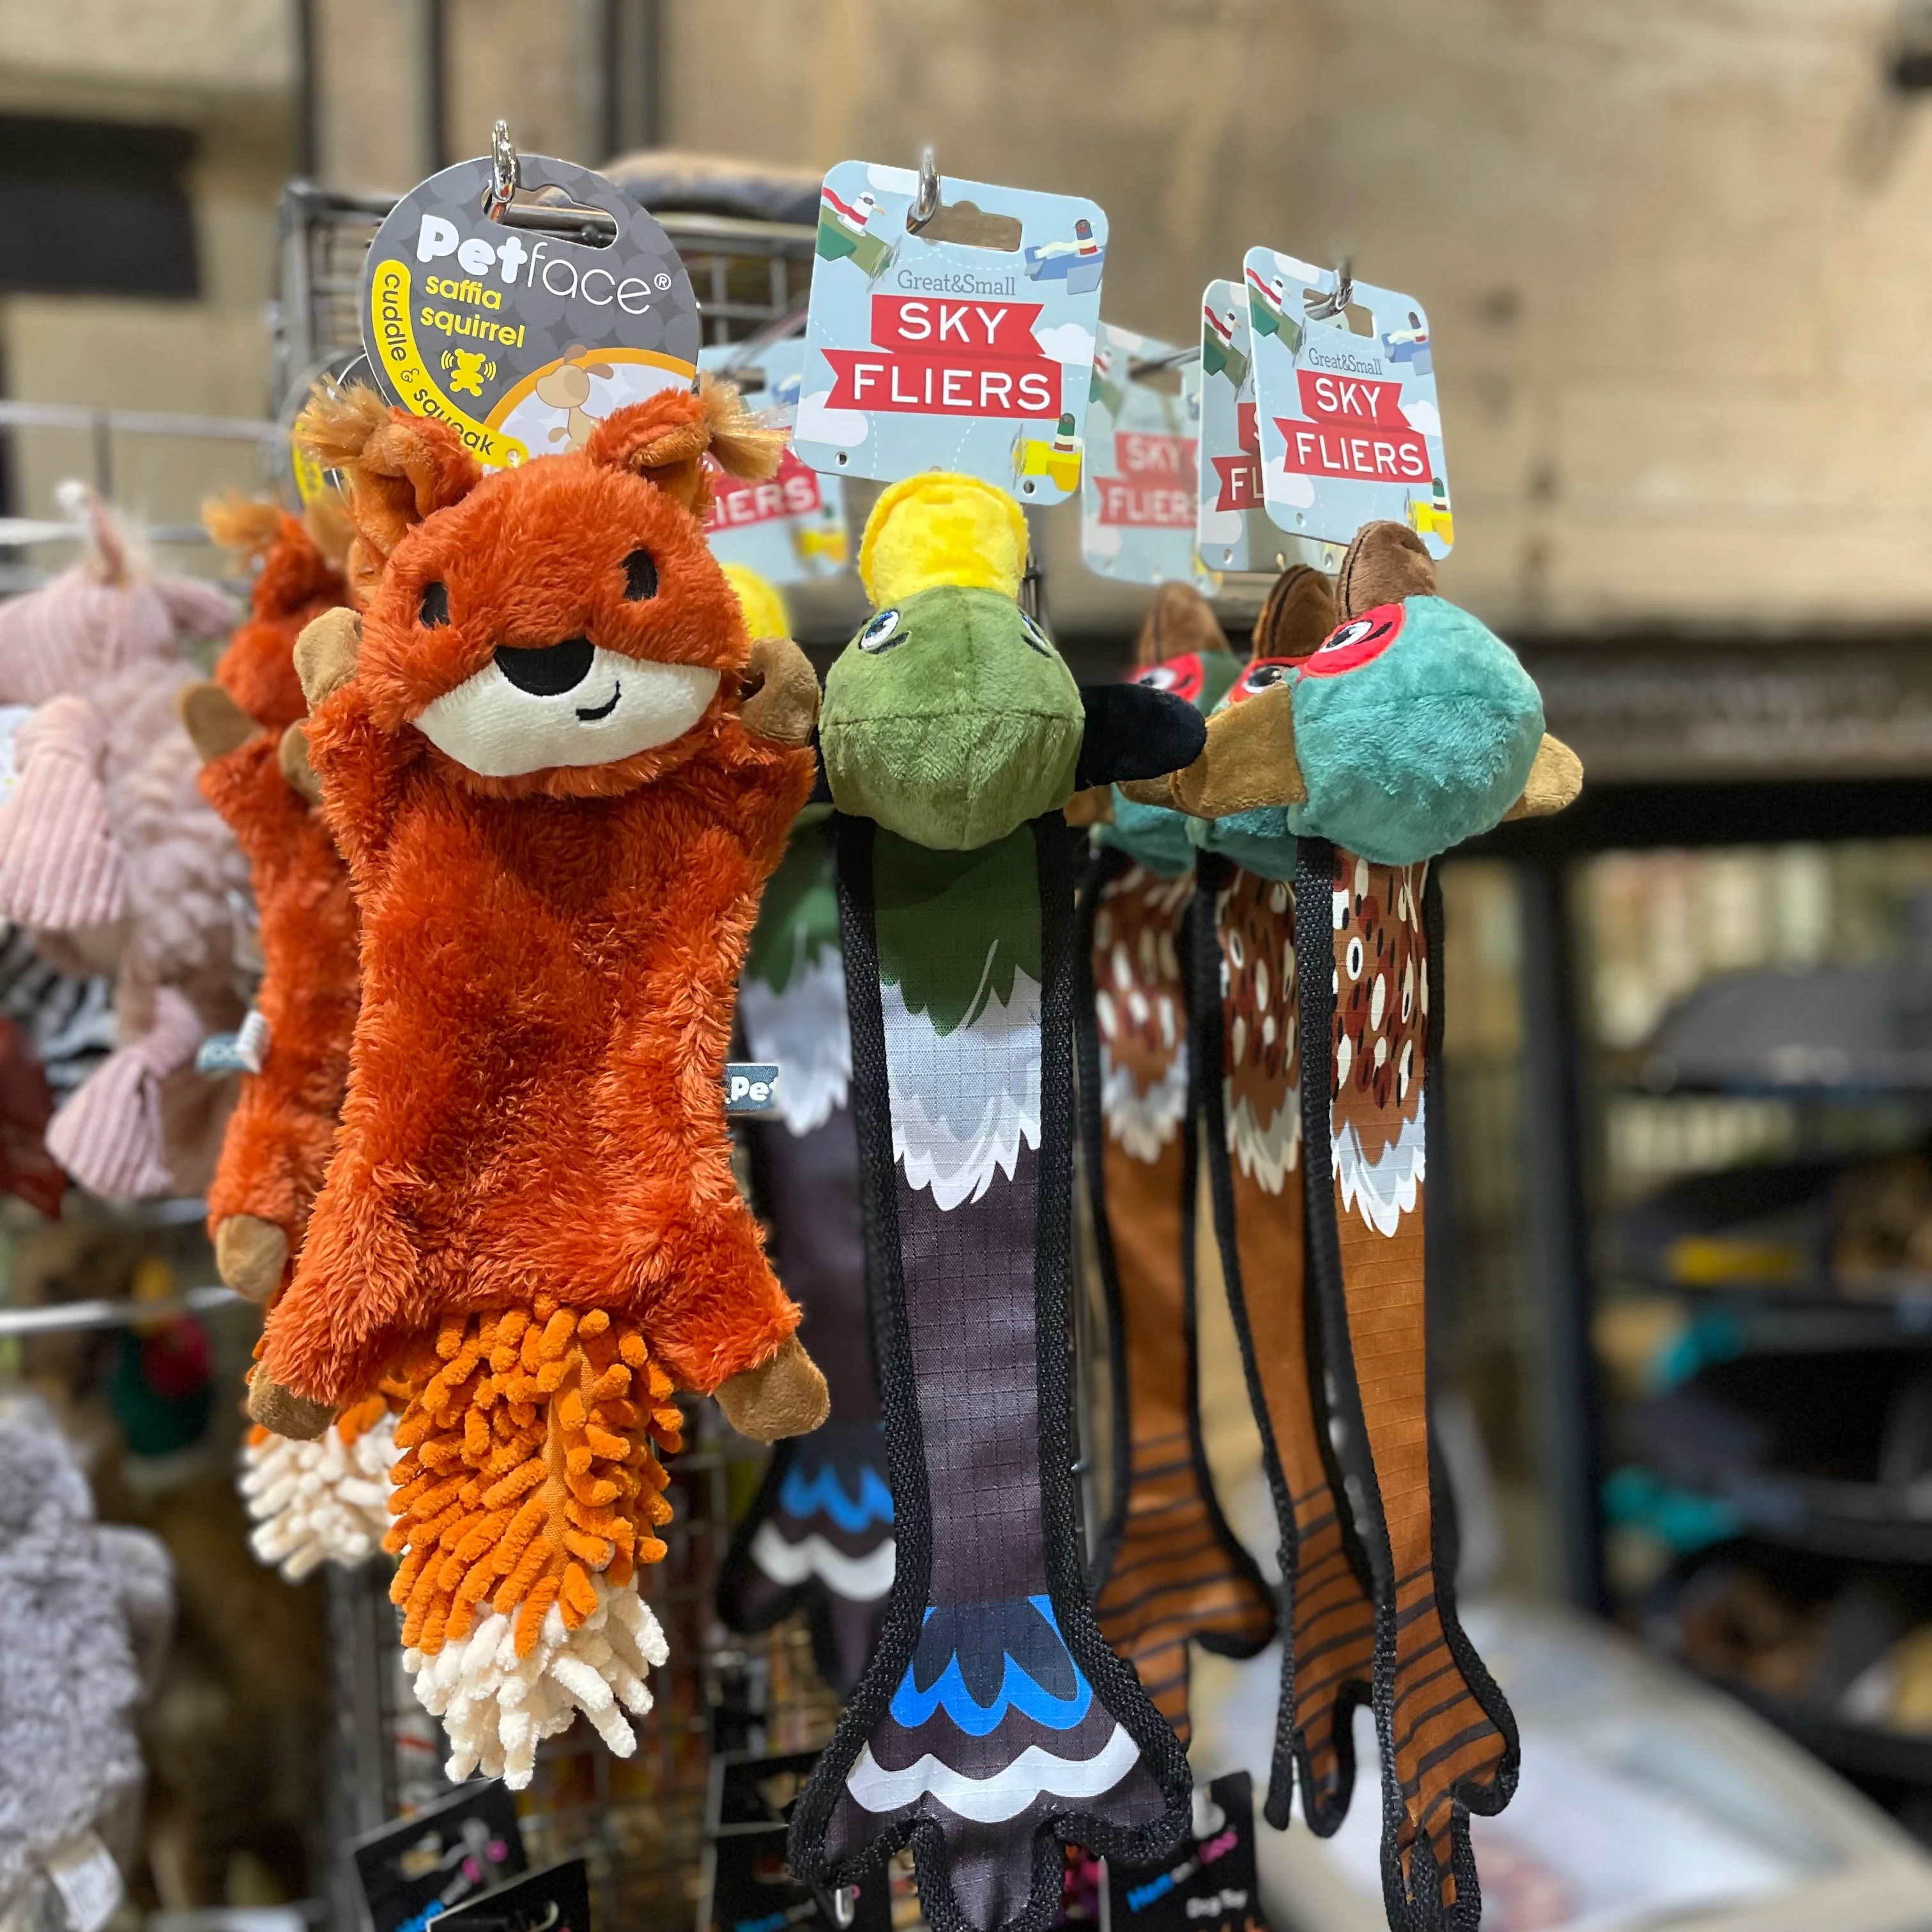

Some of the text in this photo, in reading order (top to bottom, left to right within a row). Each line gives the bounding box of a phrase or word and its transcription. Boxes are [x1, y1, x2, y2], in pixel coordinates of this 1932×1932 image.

[425, 275, 502, 310] saffia
[897, 269, 1016, 296] Great&Small
[383, 273, 408, 362] cuddle
[420, 307, 526, 348] squirrel
[898, 302, 1008, 344] SKY
[1308, 348, 1383, 376] Great&Small
[854, 364, 1051, 411] FLIERS
[1315, 378, 1381, 418] SKY
[1296, 432, 1424, 477] FLIERS
[715, 476, 815, 525] IERS
